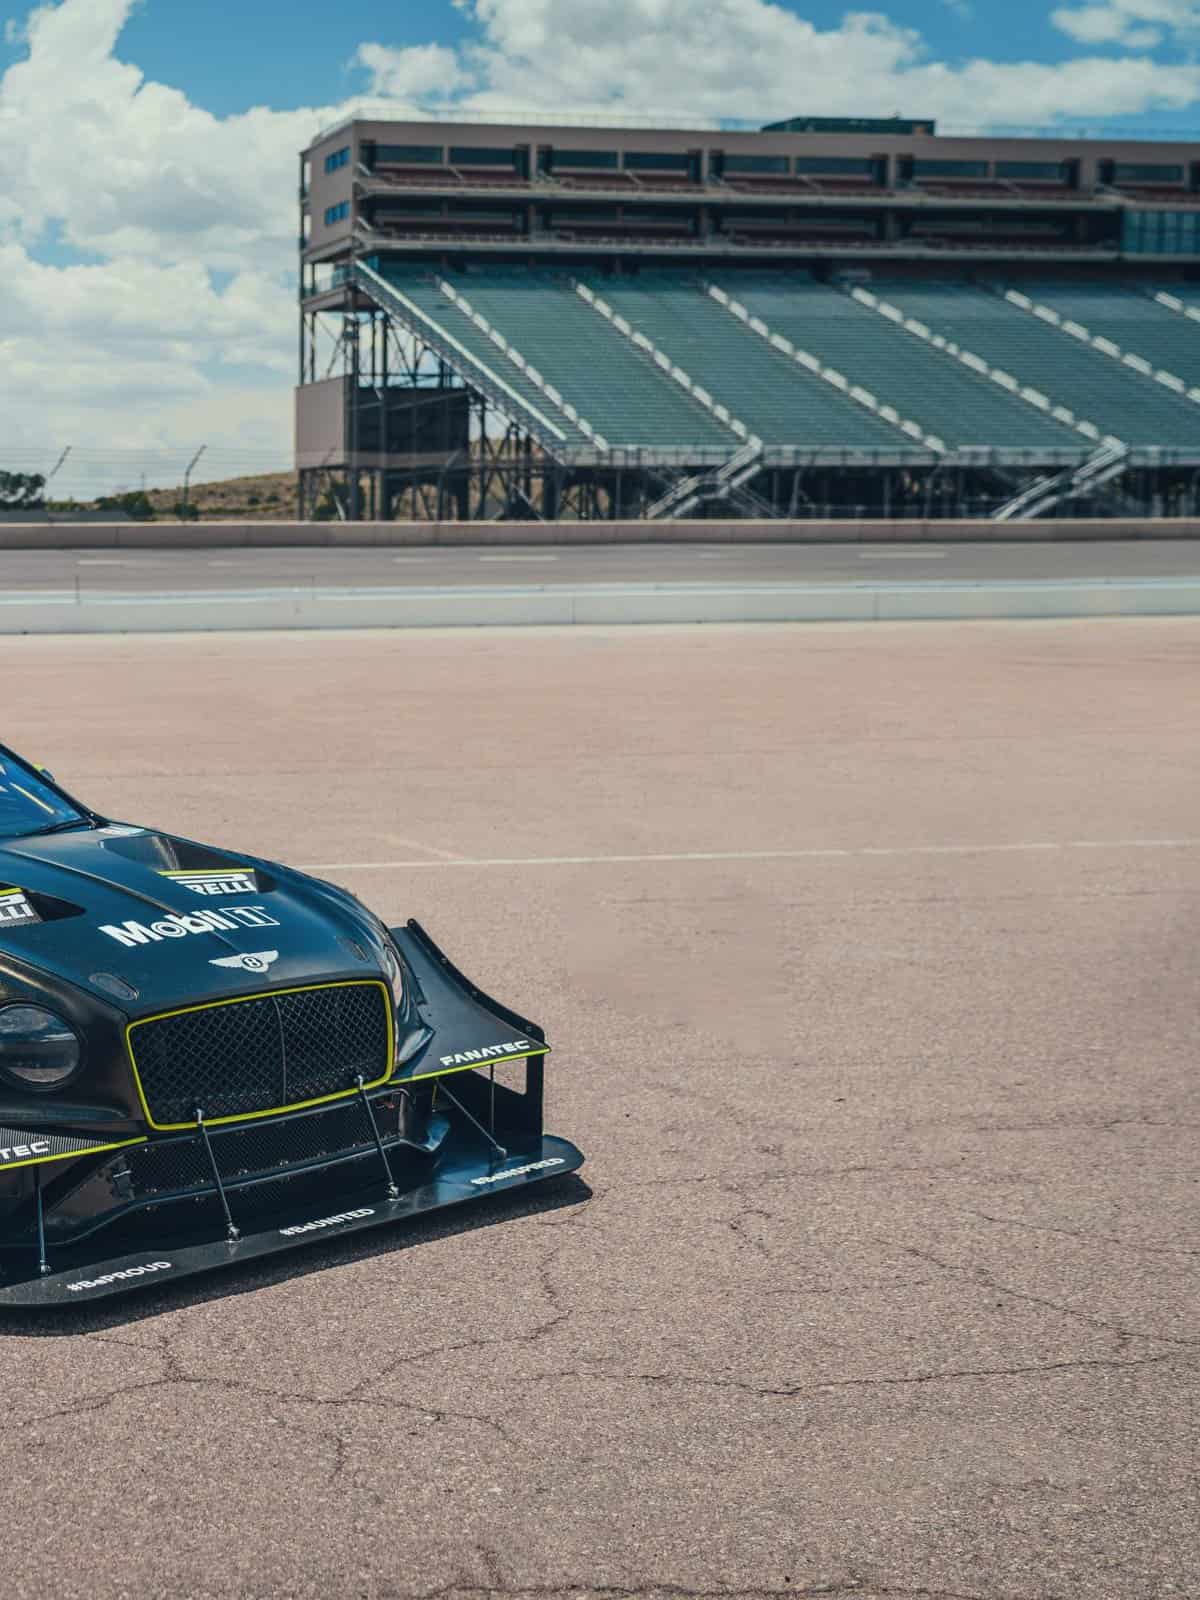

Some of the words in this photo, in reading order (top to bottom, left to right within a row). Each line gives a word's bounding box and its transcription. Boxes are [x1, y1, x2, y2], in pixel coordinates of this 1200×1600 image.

[98, 910, 239, 947] Mobil
[440, 1040, 531, 1067] FANATEC
[279, 1208, 376, 1236] #BeUNITED
[67, 1261, 172, 1291] #BePROUD
